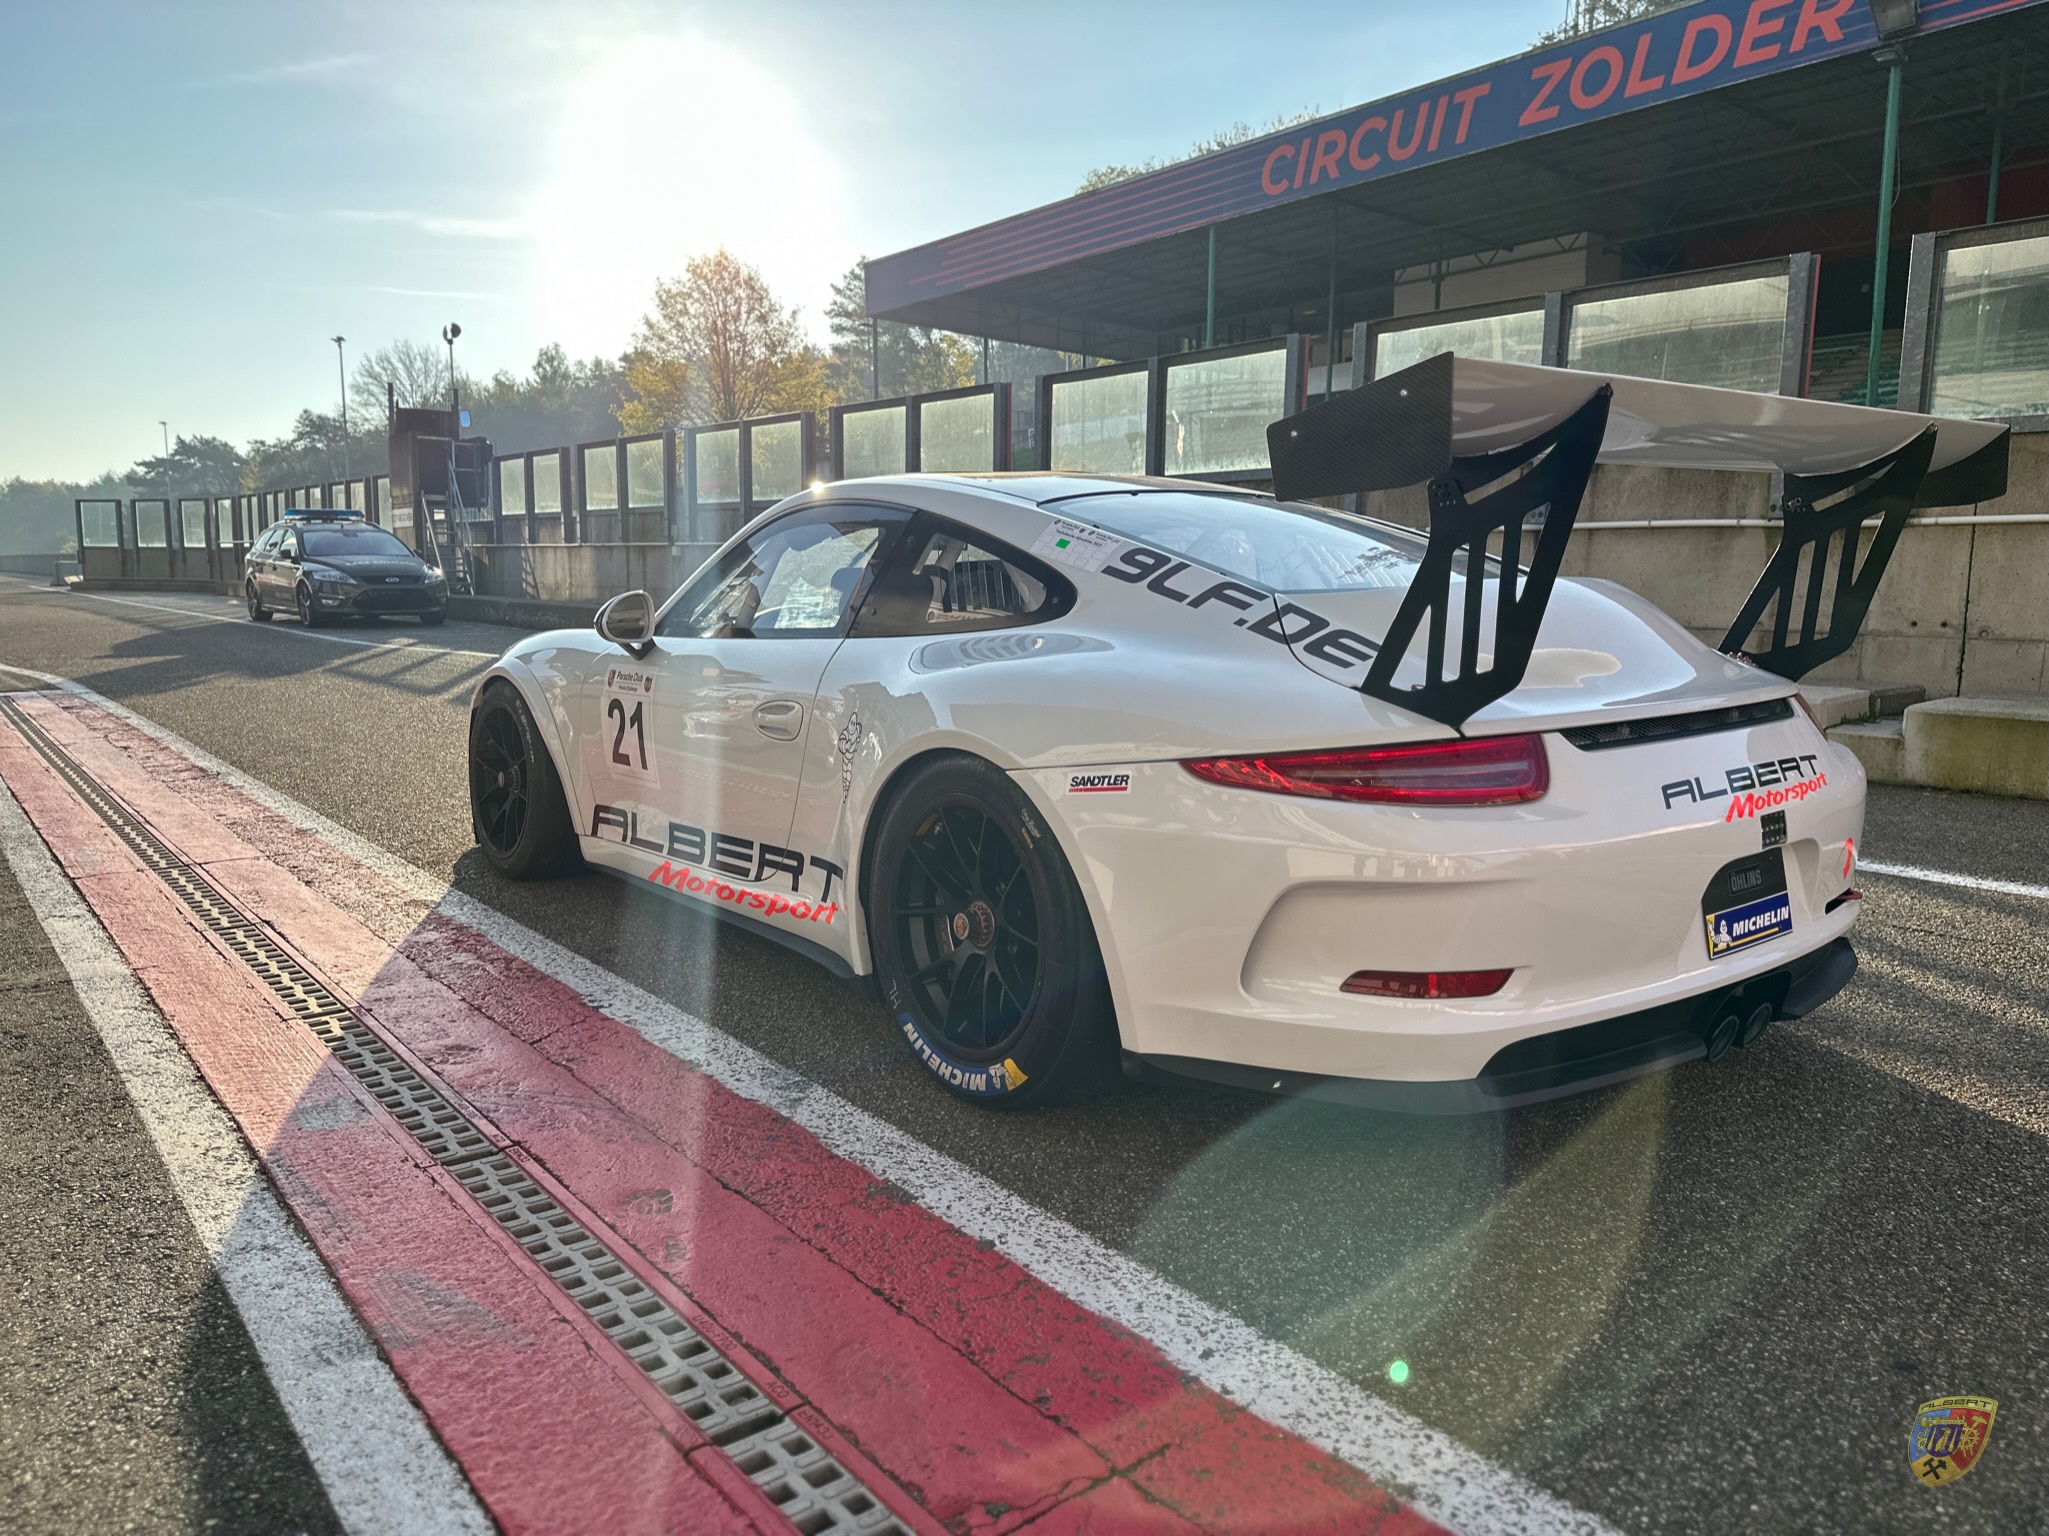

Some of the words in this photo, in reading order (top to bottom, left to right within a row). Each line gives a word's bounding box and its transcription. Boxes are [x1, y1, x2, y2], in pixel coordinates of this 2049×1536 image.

[1260, 82, 1491, 196] CIRCUIT
[1518, 0, 1856, 128] ZOLDER
[1100, 547, 1383, 669] 9LF.DE
[617, 670, 633, 681] Porsche
[633, 672, 644, 682] Club
[607, 697, 649, 771] 21
[1069, 774, 1130, 787] SANDTLER
[1661, 754, 1818, 810] ALBERT
[1725, 772, 1828, 823] Motorsport
[590, 803, 844, 903] ALBERT
[1730, 869, 1762, 892] ÖHLINS
[647, 860, 840, 925] Motorsport
[1732, 905, 1790, 937] MICHELIN
[903, 1021, 987, 1092] MICHELIN
